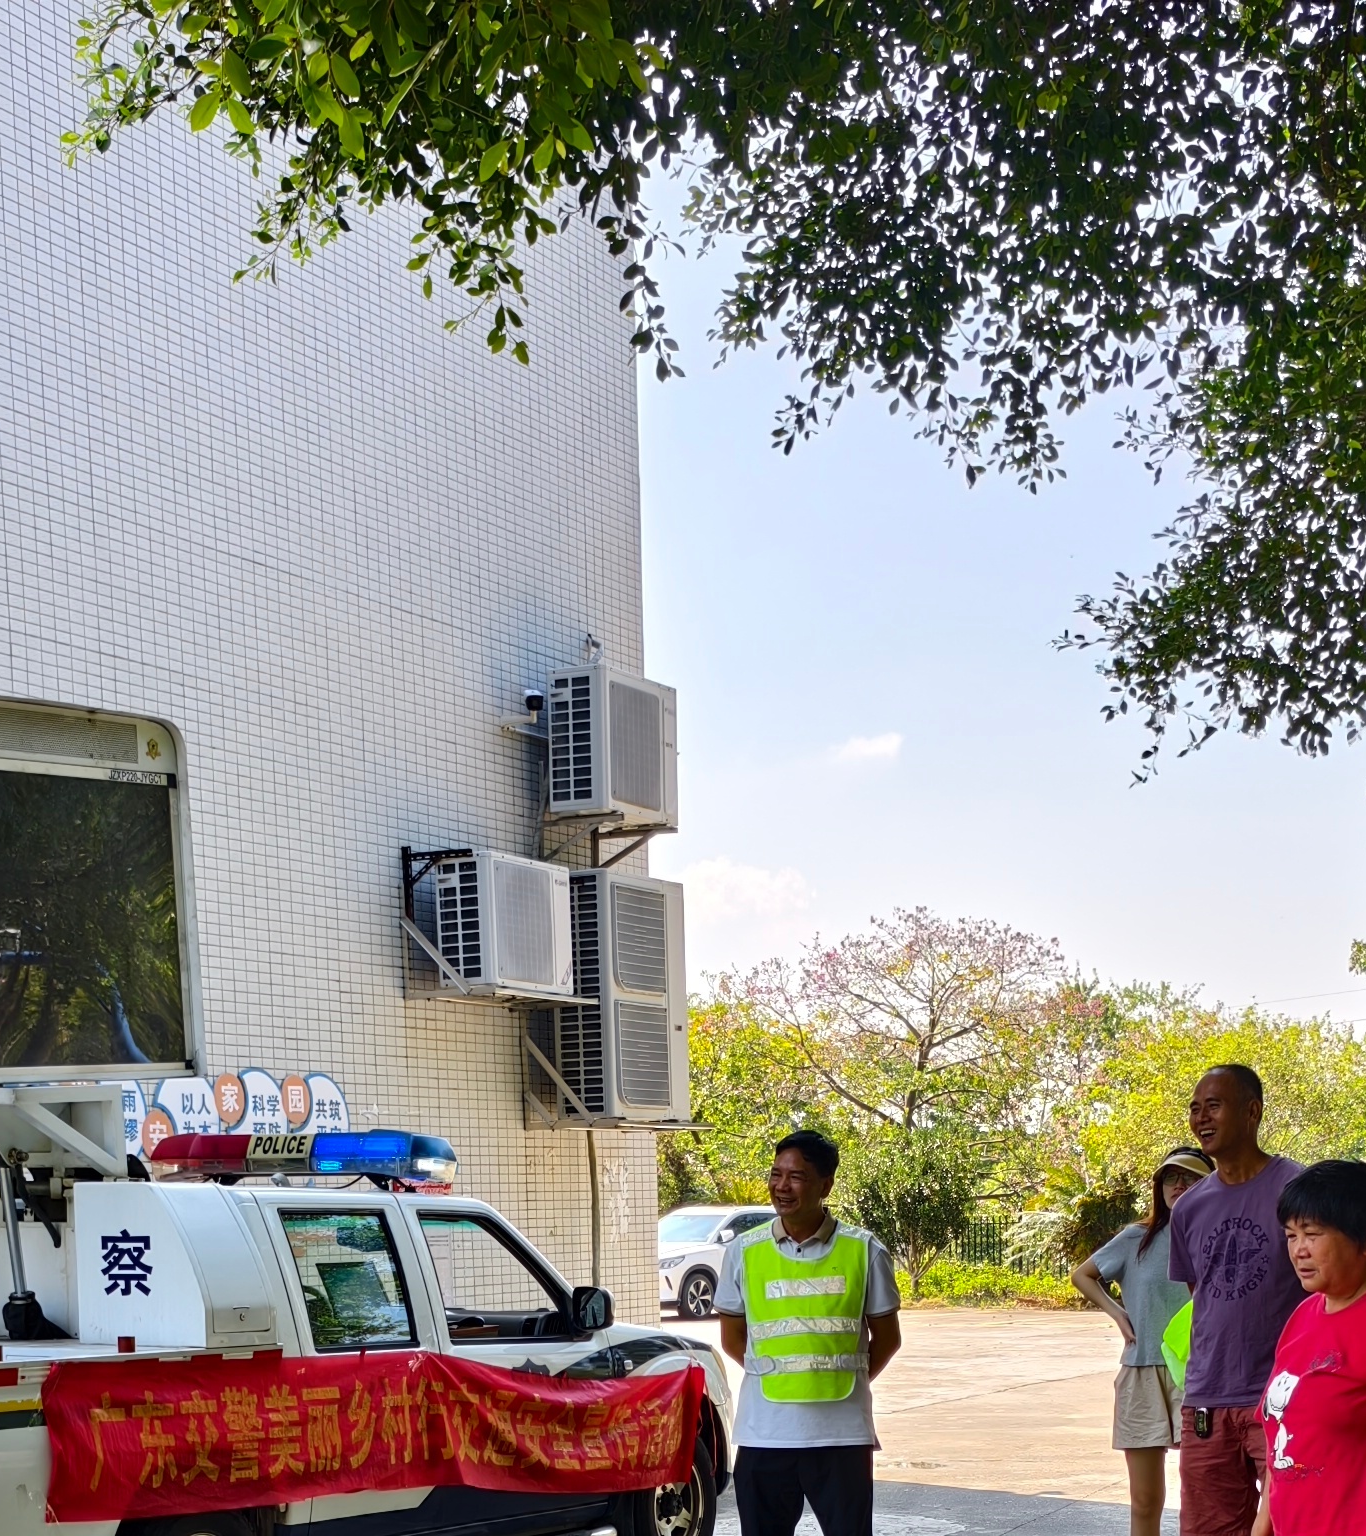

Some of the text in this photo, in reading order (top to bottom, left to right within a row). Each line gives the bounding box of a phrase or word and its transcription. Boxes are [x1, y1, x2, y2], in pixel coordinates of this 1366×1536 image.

[181, 1093, 212, 1116] 以人
[221, 1083, 240, 1113] 家
[252, 1094, 281, 1118] 科学
[287, 1086, 305, 1113] 园
[315, 1099, 342, 1121] 共筑
[252, 1135, 308, 1155] POLICE
[1202, 1217, 1270, 1255] SALTROCK
[100, 1229, 153, 1297] 察
[1224, 1266, 1268, 1302] KNGM
